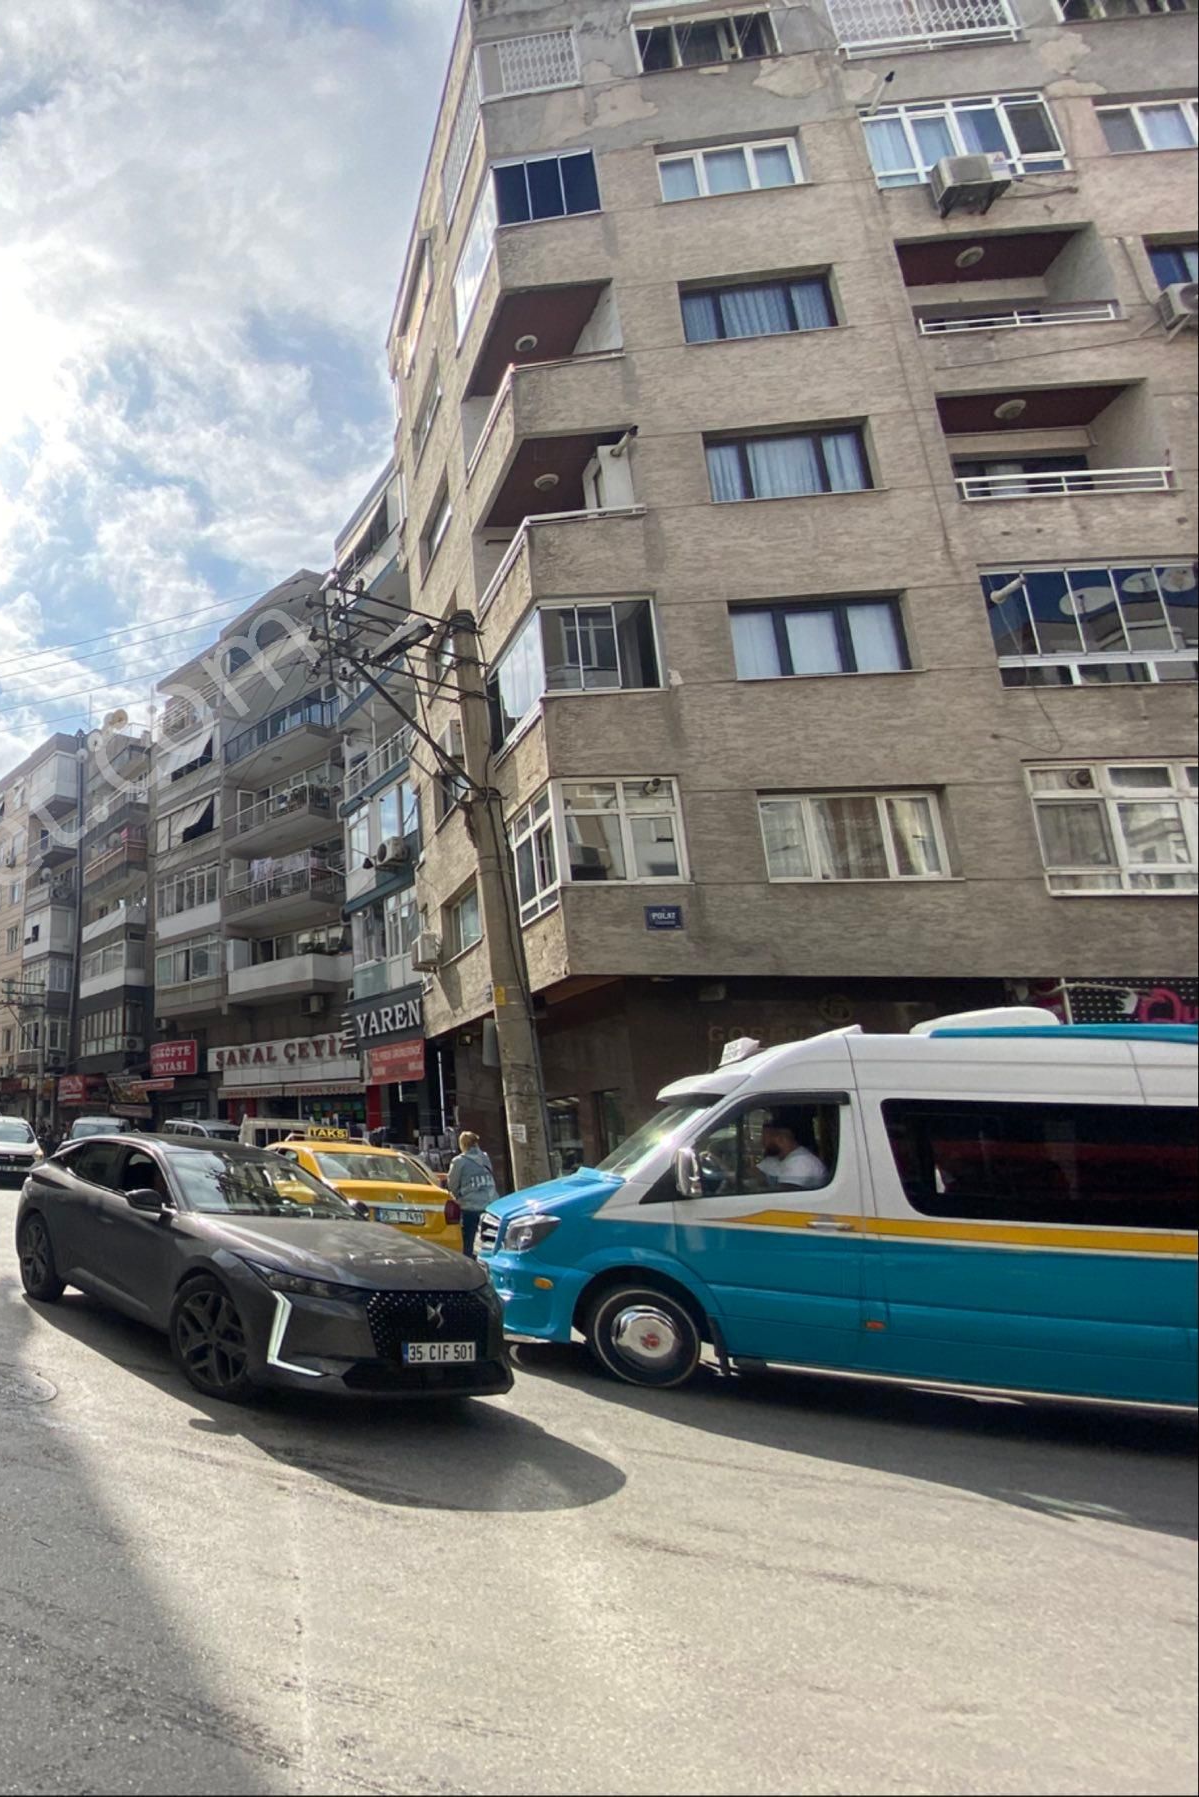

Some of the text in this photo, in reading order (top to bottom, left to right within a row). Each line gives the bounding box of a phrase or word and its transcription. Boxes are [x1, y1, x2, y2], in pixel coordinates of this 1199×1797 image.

[356, 999, 421, 1038] YAREN
[409, 1344, 473, 1360] 35 CIF 501
